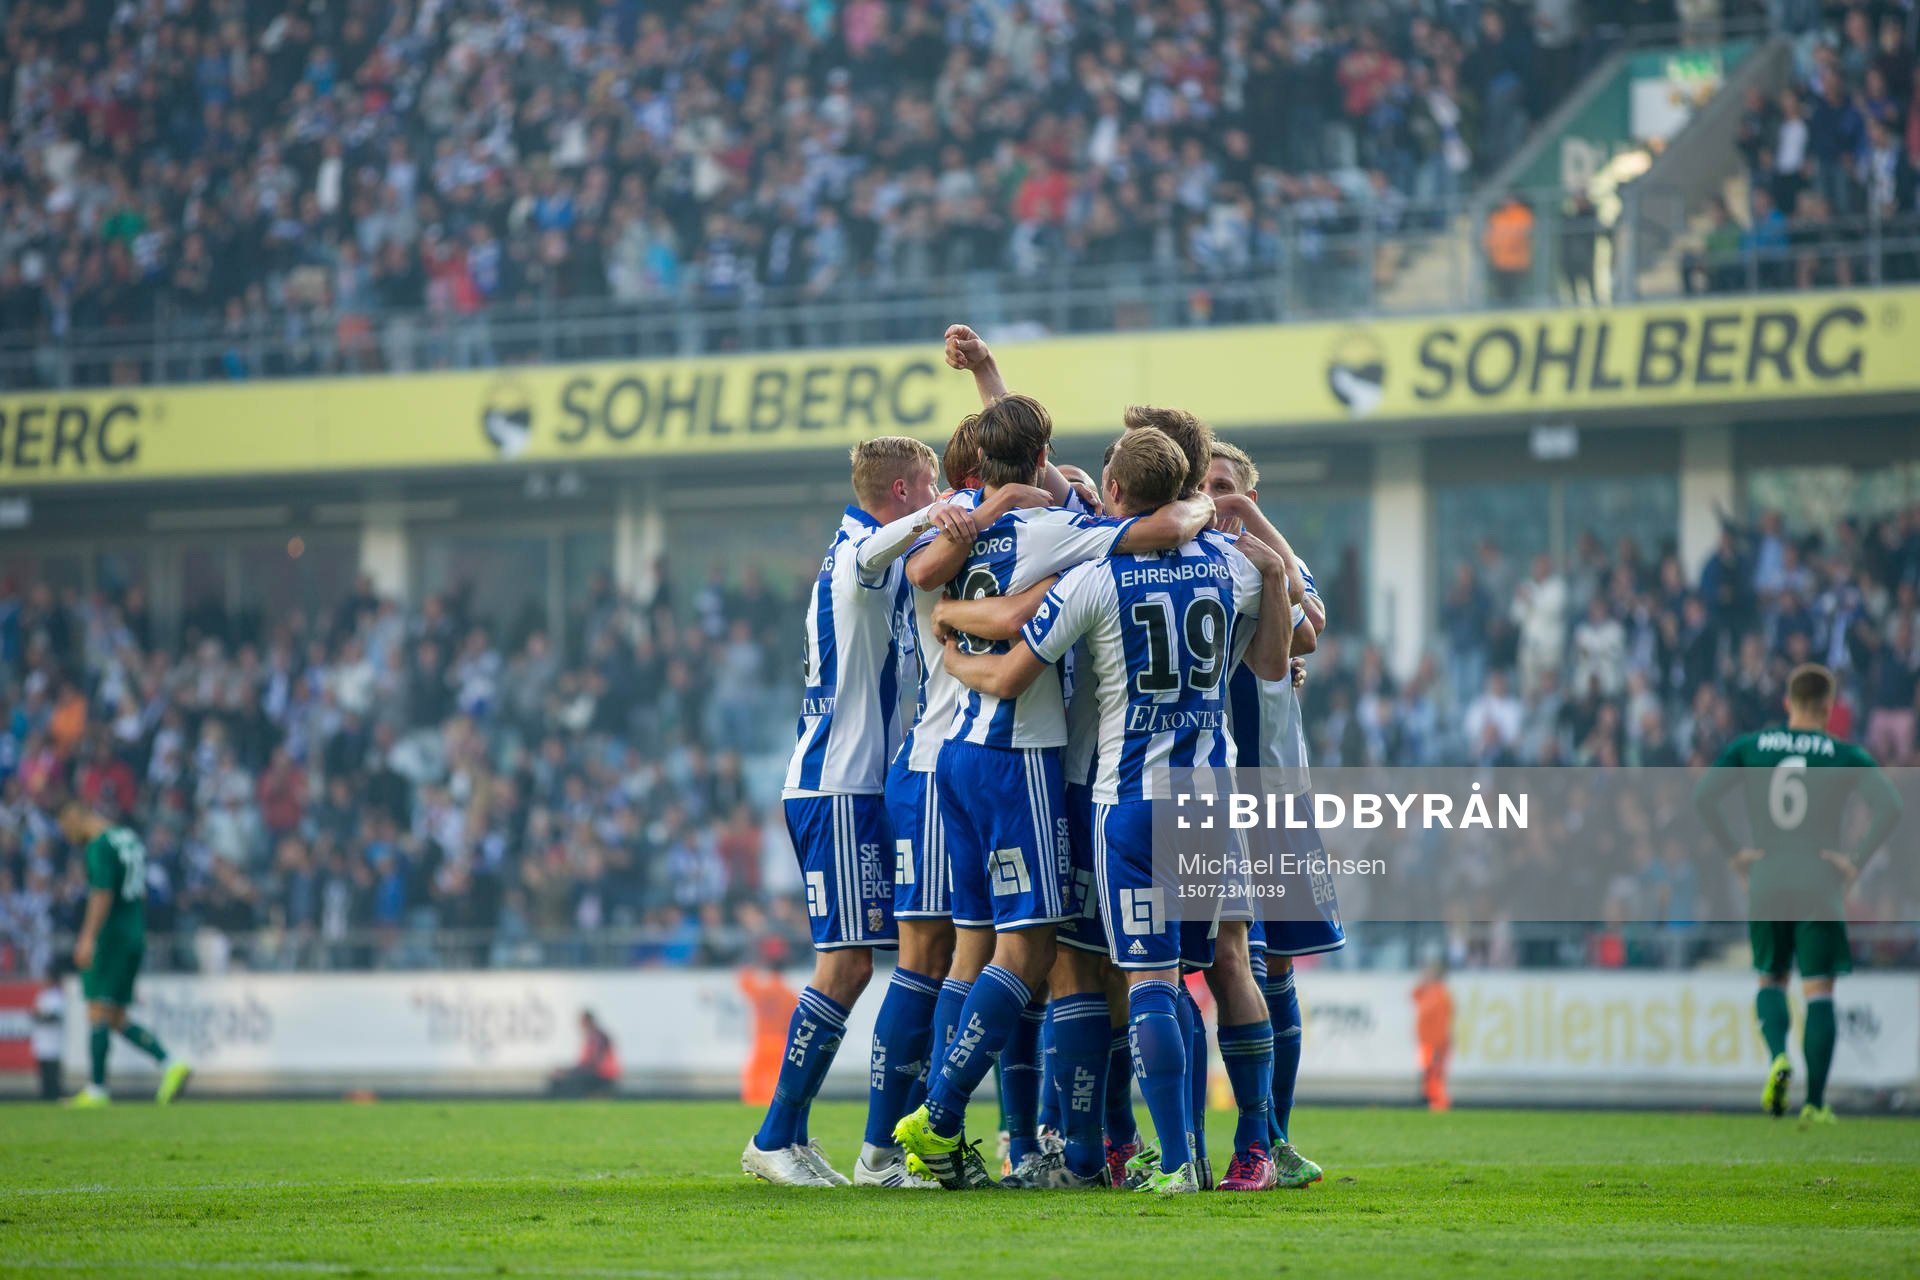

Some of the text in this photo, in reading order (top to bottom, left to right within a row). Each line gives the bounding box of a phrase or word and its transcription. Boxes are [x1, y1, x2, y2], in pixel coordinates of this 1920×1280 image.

[1413, 305, 1868, 400] SOHLBERG
[0, 403, 139, 467] ERG
[556, 362, 940, 444] SOHLBERG
[968, 537, 1012, 557] ORG
[1121, 563, 1230, 587] EHRENBORG
[1131, 594, 1228, 693] 19
[1757, 732, 1835, 757] HOLOTA
[1768, 755, 1808, 830] 6
[1450, 980, 1808, 1065] allensta
